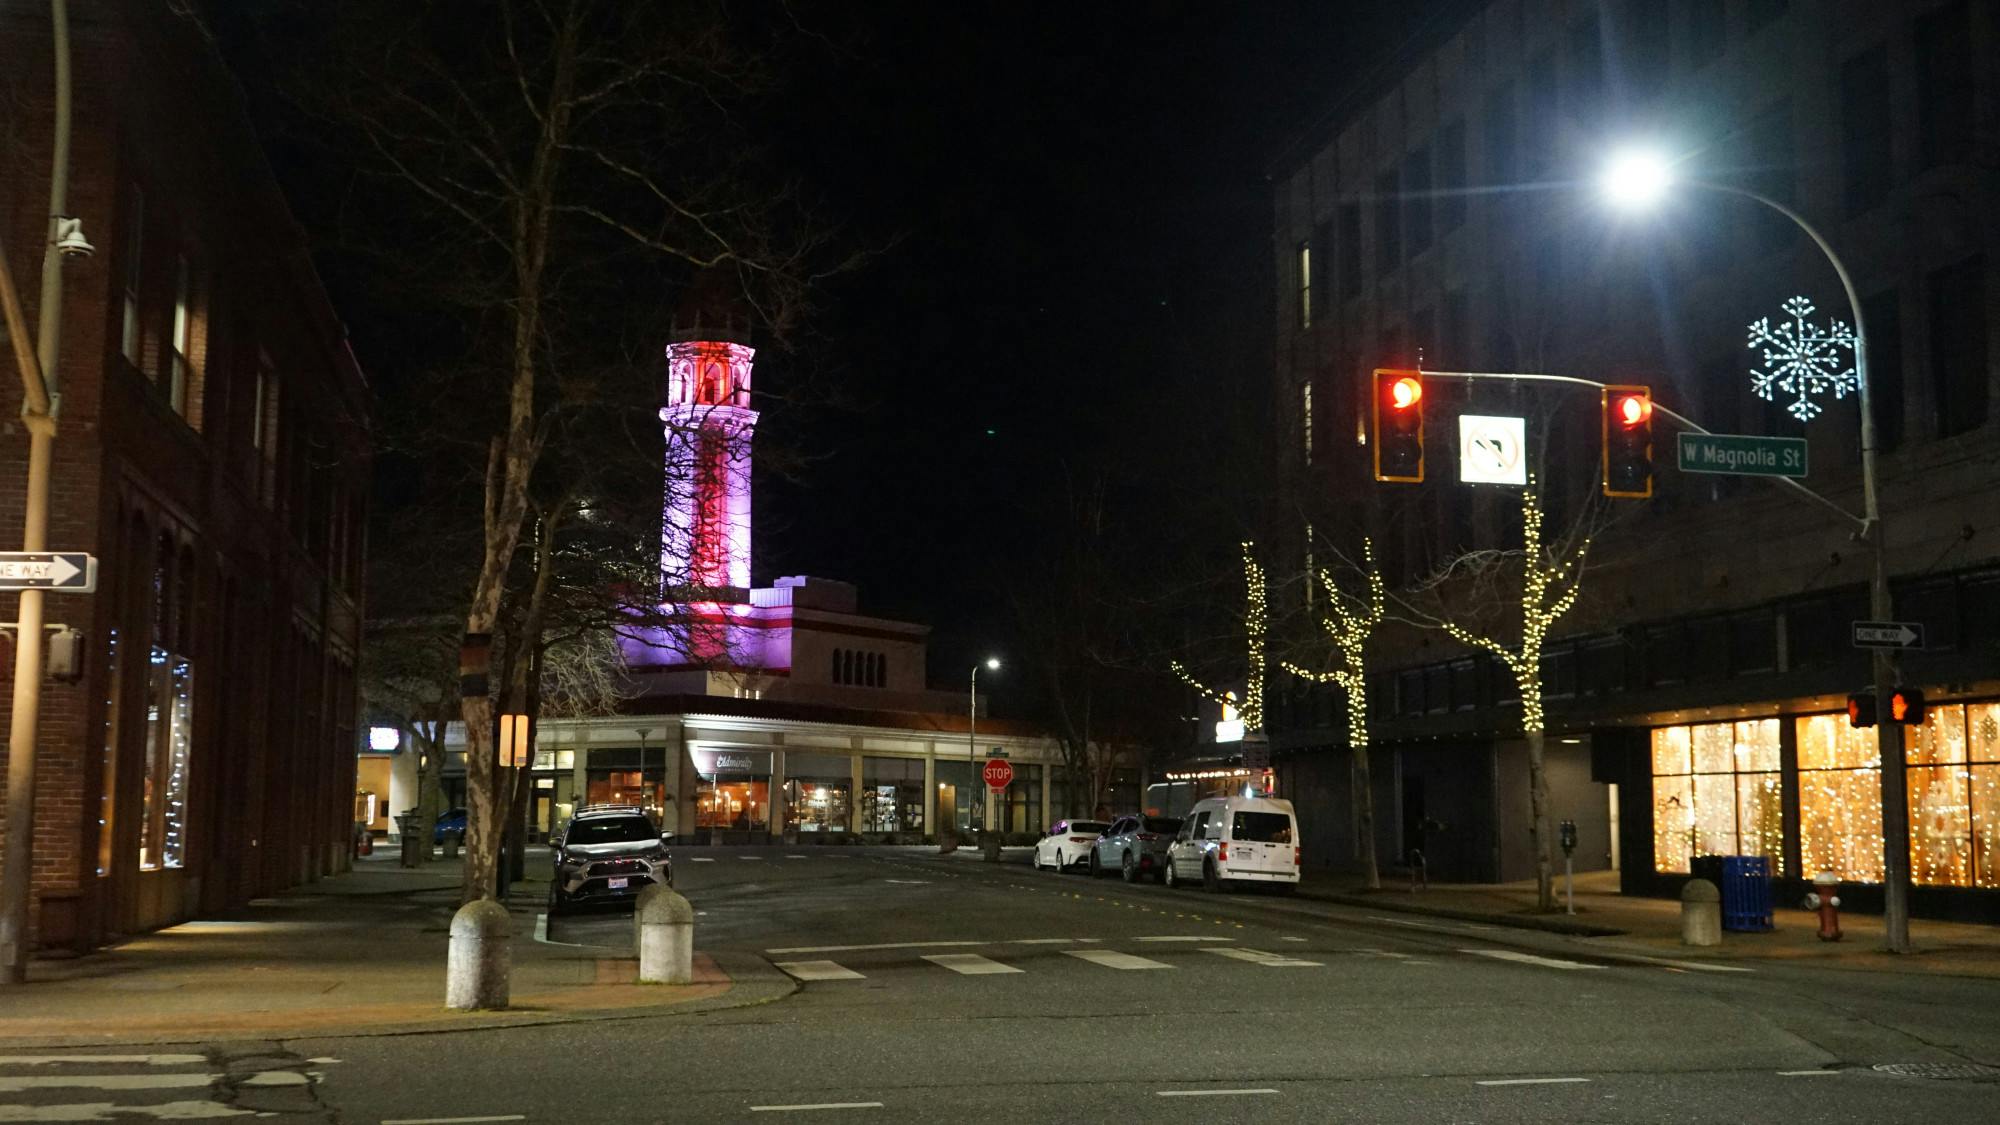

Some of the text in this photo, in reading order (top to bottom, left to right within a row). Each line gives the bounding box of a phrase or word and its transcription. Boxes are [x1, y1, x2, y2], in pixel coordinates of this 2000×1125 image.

[1684, 442, 1801, 470] W Magnolia St
[21, 564, 50, 577] WAY
[1859, 629, 1900, 641] ONE WAY
[985, 767, 1010, 779] STOP
